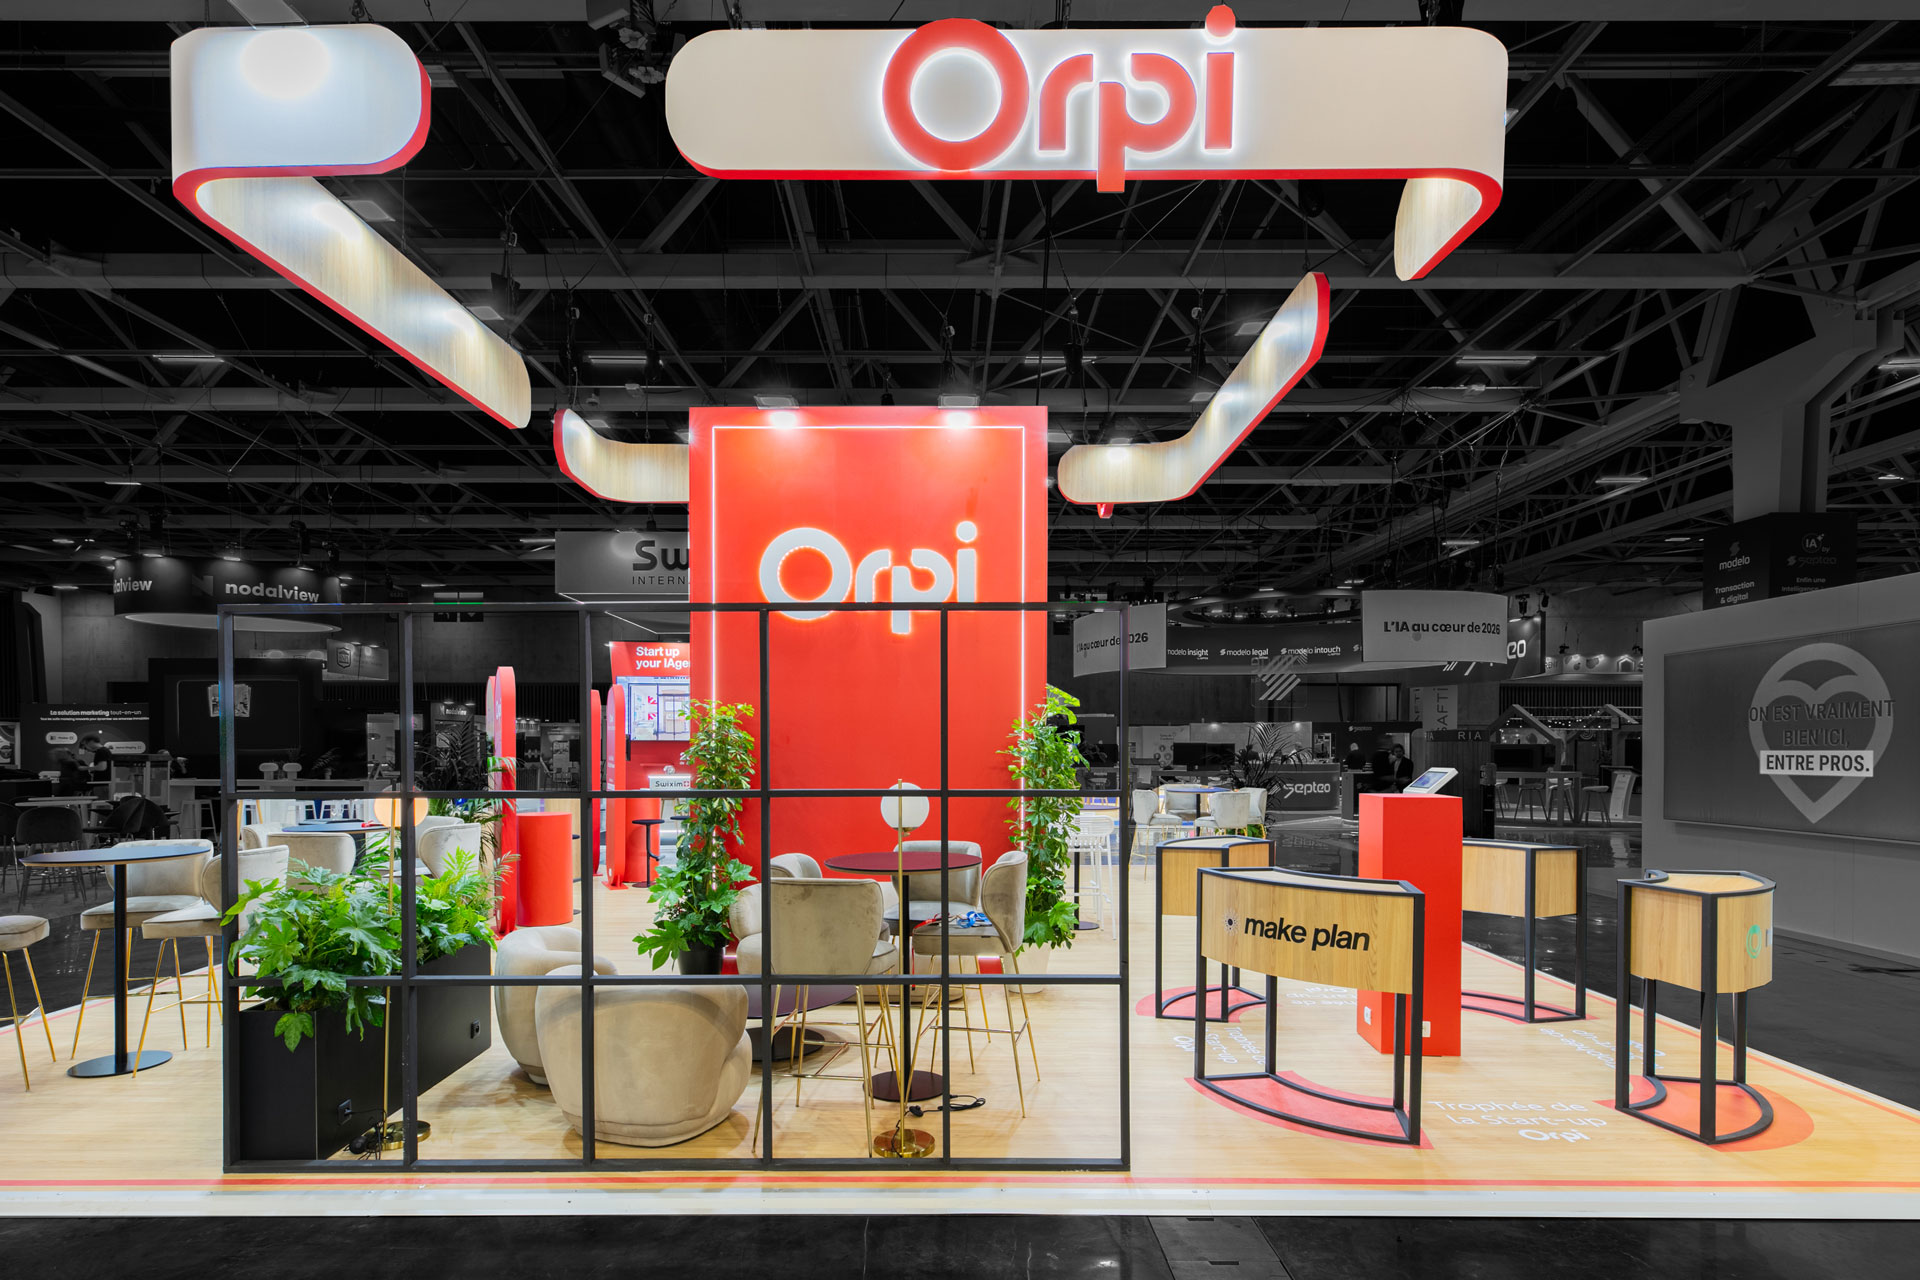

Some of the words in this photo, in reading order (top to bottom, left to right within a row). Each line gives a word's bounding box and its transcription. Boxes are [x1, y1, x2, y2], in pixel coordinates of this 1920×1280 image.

[883, 5, 1236, 193] Orpi
[1805, 538, 1818, 548] IA
[1719, 555, 1751, 571] modelo
[759, 520, 977, 634] Orpi
[225, 582, 319, 602] nodalview
[1714, 581, 1755, 595] Transaction
[1720, 596, 1726, 605] &
[1726, 592, 1749, 604] digital
[1411, 622, 1430, 632] au
[1431, 622, 1466, 633] cœur
[1467, 621, 1481, 633] de
[1481, 622, 1501, 635] 2026
[1109, 635, 1120, 646] de
[1127, 631, 1148, 644] 026
[636, 646, 664, 657] Start
[665, 647, 680, 659] up
[1226, 648, 1251, 656] modelo
[1251, 648, 1269, 657] legal
[1314, 646, 1341, 654] intouch
[636, 659, 661, 670] your
[80, 709, 109, 717] marketing
[1749, 705, 1769, 722] ON
[1774, 704, 1802, 721] EST
[1806, 699, 1896, 720] VRAIMENT
[1457, 731, 1482, 742] RIA
[1766, 754, 1814, 771] ENTRE
[1819, 754, 1870, 772] PROS.
[655, 780, 683, 788] Swixim
[1244, 917, 1307, 943] make
[1311, 924, 1370, 951] plan
[1427, 1100, 1546, 1113] Trophée
[1550, 1101, 1589, 1112] de
[1445, 1114, 1480, 1125] la
[1480, 1114, 1608, 1128] Start-up
[1517, 1128, 1591, 1143] Orpi
